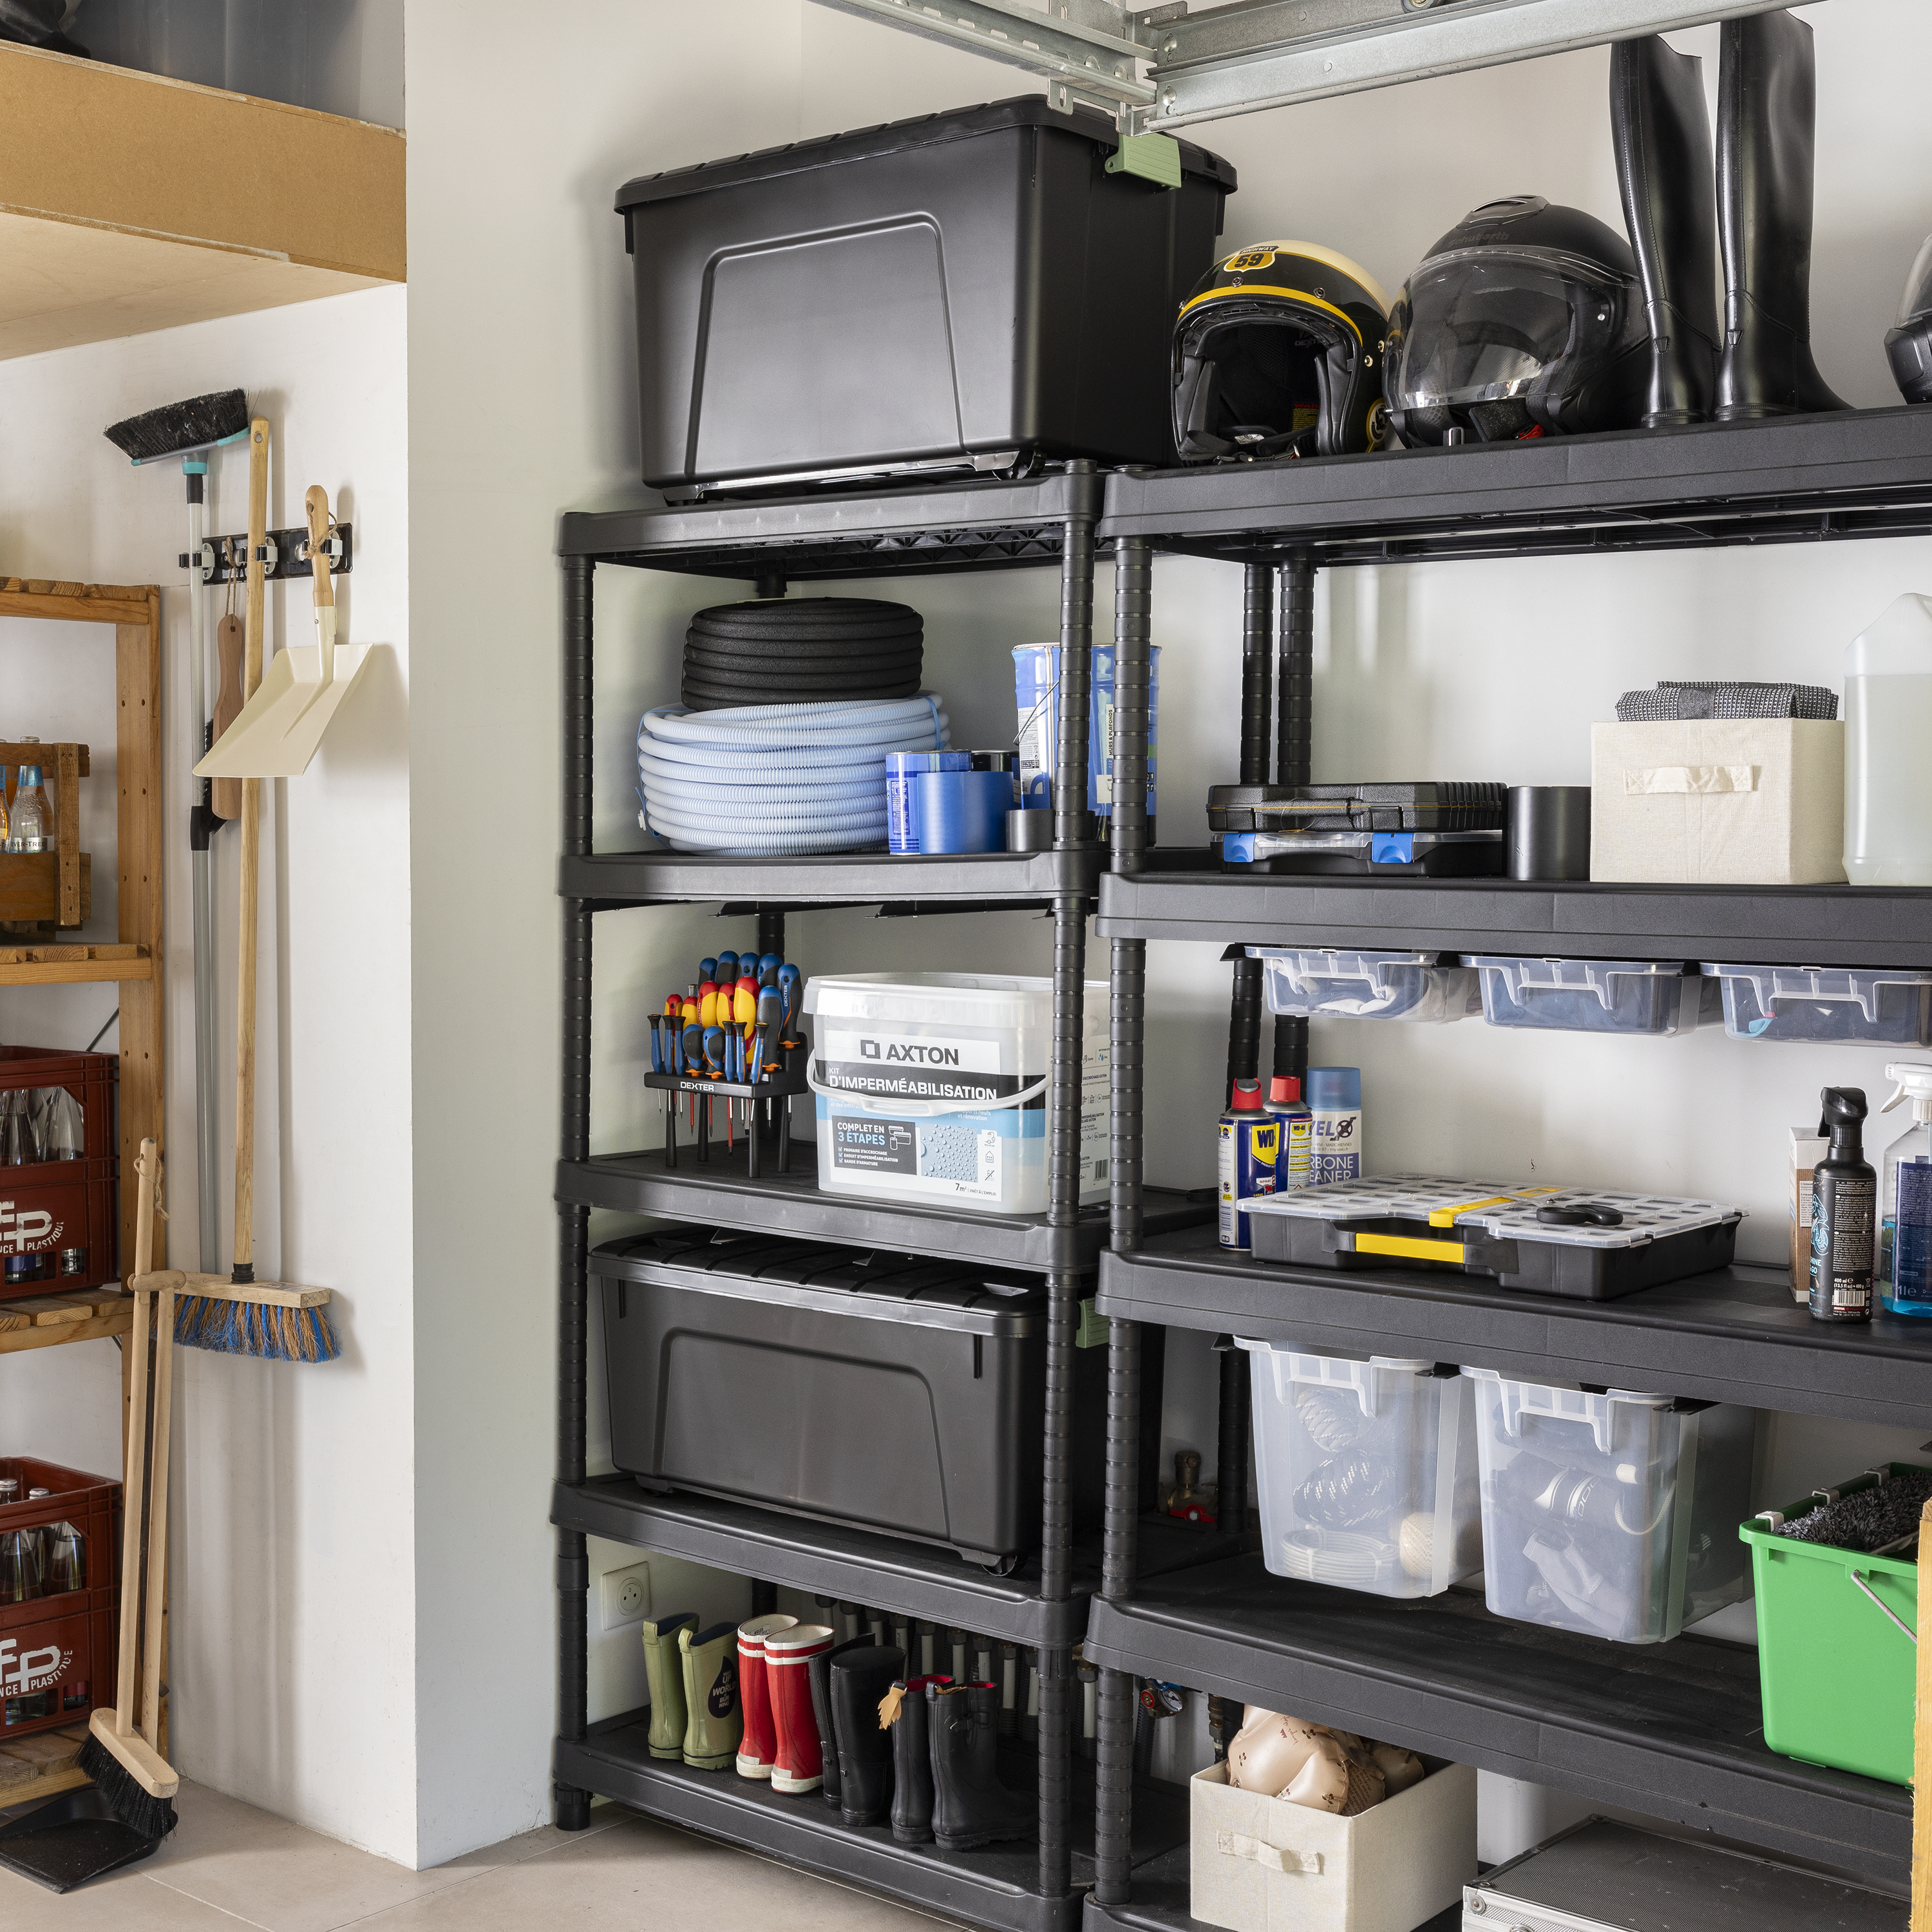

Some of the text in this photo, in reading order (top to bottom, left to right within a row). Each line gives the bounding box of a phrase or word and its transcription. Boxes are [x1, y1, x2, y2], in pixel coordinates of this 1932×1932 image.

[1234, 253, 1264, 268] 59
[886, 1044, 960, 1066] AXTON
[680, 1081, 714, 1092] DEXTER
[829, 1075, 997, 1101] D'IMPERMÉABILISATION
[837, 1122, 885, 1133] COMPLET EN
[838, 1129, 886, 1145] 3 ÉTAPES
[723, 1674, 732, 1683] UP
[712, 1681, 736, 1696] WORLD
[719, 1695, 730, 1703] BUR
